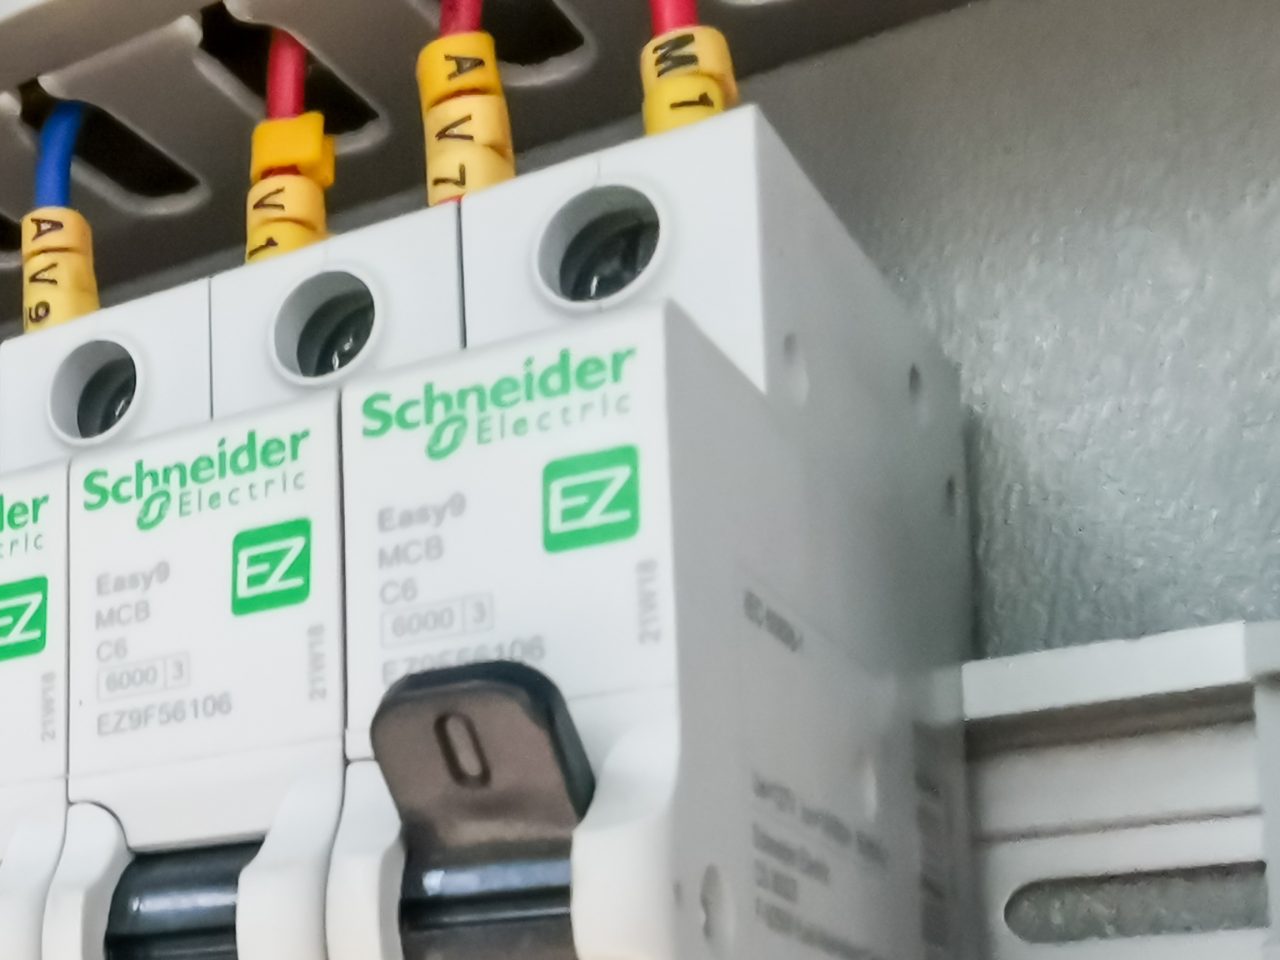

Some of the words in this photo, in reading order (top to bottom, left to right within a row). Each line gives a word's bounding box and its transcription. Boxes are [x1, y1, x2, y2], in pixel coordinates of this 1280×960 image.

[652, 33, 715, 111] M1
[433, 52, 486, 187] AV7
[362, 346, 636, 437] Schneider
[477, 391, 631, 445] Electric
[83, 428, 310, 511] Schneider
[179, 470, 305, 518] Electric
[378, 536, 444, 569] MCB
[380, 578, 417, 606] C6
[95, 600, 150, 631] MCB
[391, 607, 454, 637] 6000
[96, 637, 127, 663] C6
[106, 665, 157, 693] 6000
[97, 691, 232, 736] EZ9F56106
